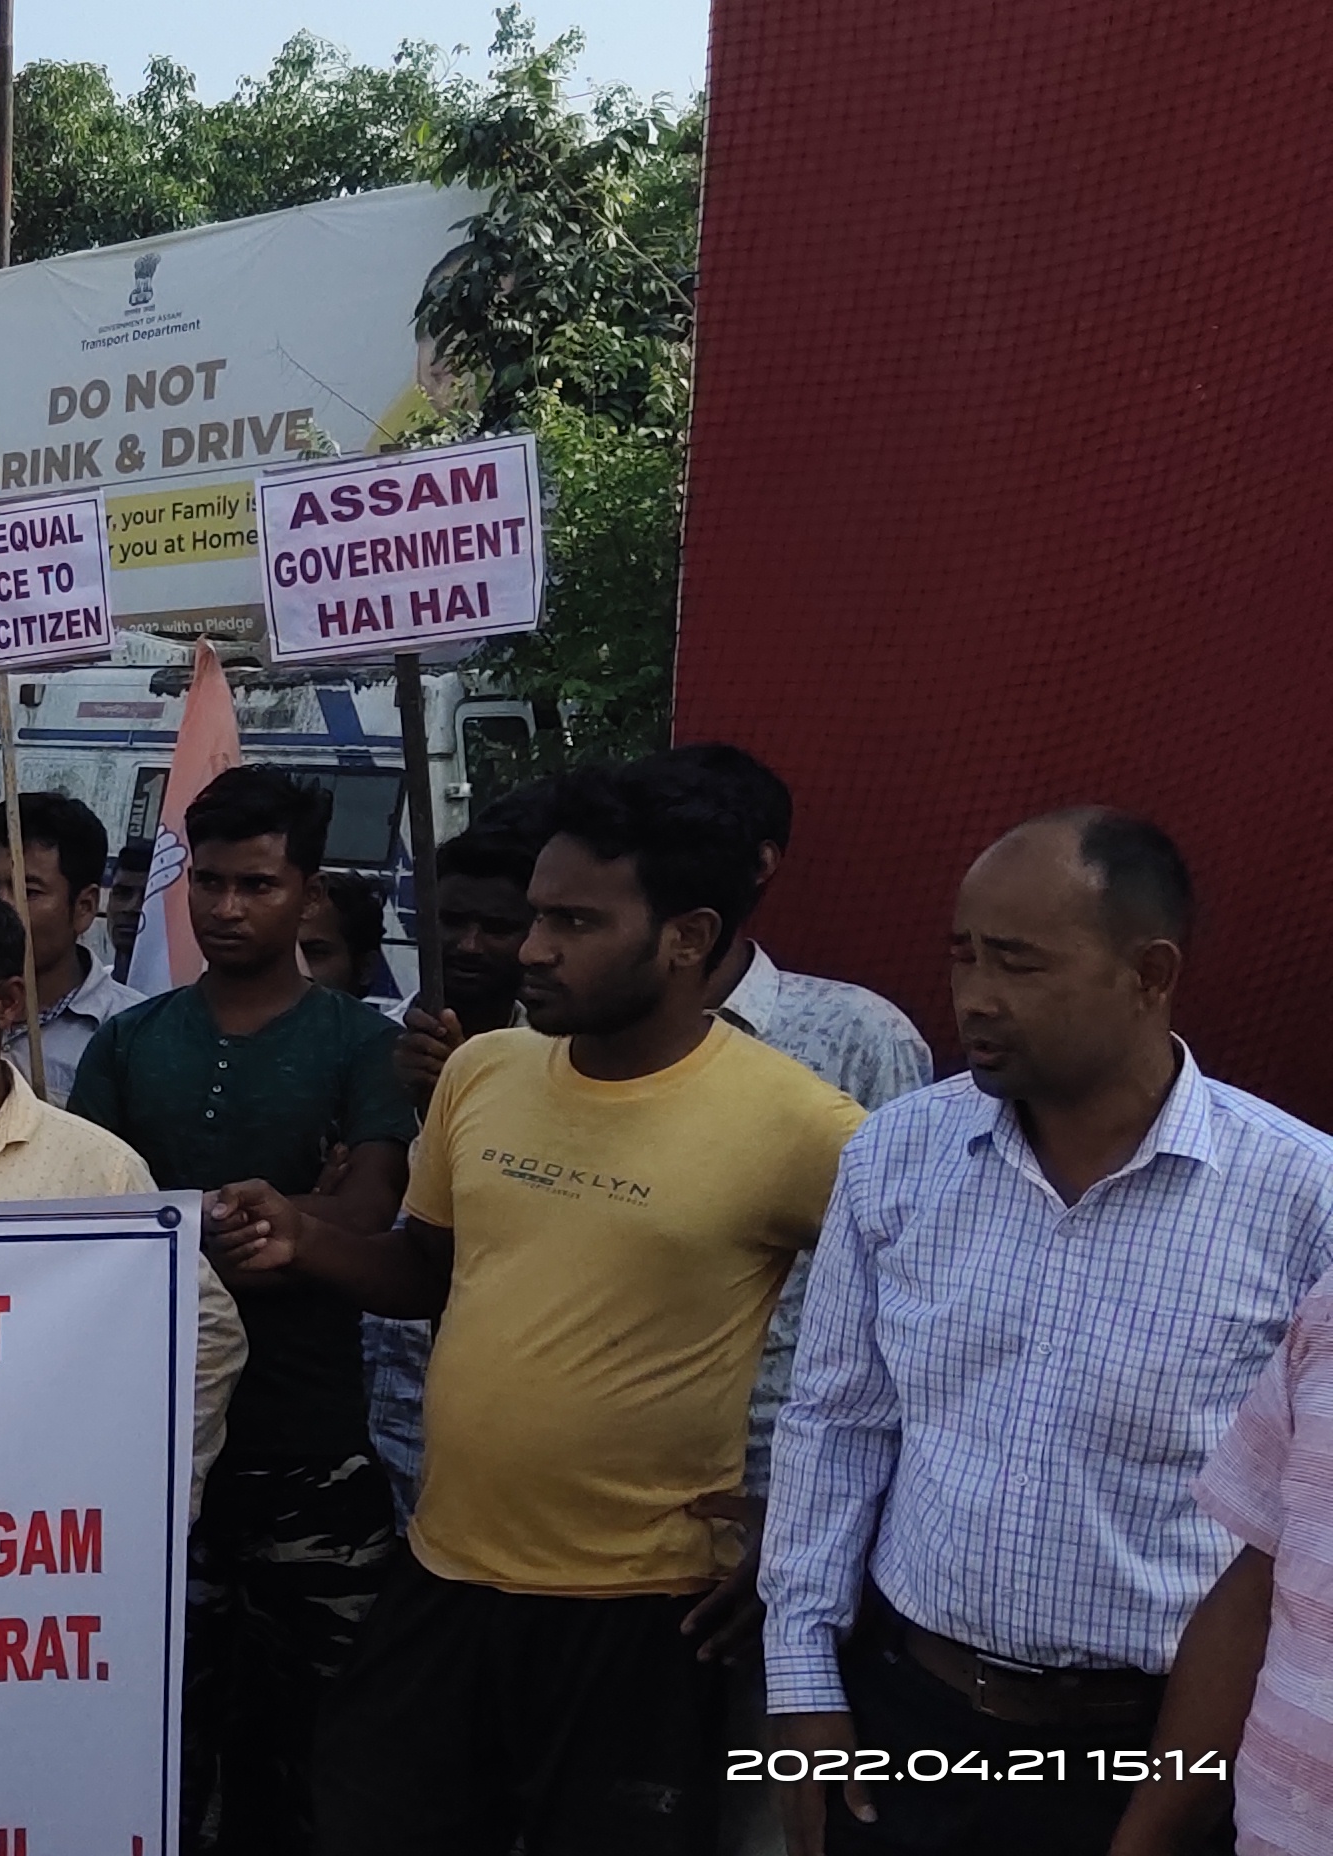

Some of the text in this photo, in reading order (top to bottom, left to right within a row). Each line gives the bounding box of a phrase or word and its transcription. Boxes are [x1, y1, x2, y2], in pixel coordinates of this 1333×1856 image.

[81, 319, 200, 351] Transport Department
[48, 359, 227, 425] DO NOT
[115, 434, 146, 474] &
[162, 407, 314, 468] DRIVE
[121, 507, 165, 531] your
[172, 494, 239, 520] Family
[290, 463, 498, 530] ASSAM
[119, 539, 157, 564] you
[164, 534, 185, 554] at
[192, 529, 258, 551] Home
[275, 518, 525, 587] GOVERNMENT
[38, 563, 73, 595] TO
[194, 622, 203, 632] a
[206, 616, 254, 634] Pledge
[318, 582, 489, 638] HAI HAI
[129, 796, 147, 837] CALL
[481, 1149, 651, 1199] BROOKLYN
